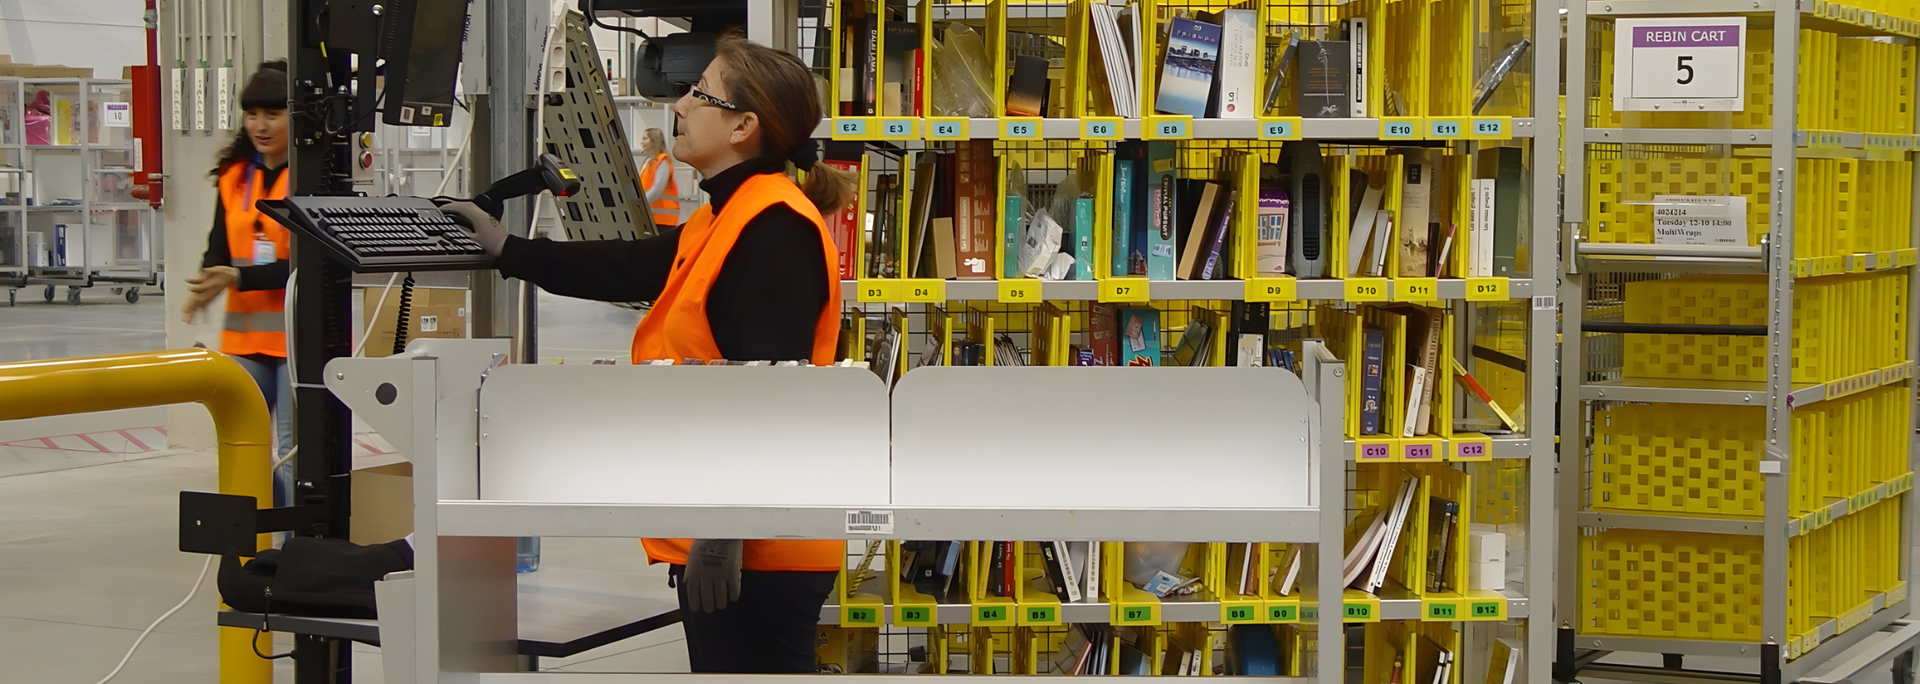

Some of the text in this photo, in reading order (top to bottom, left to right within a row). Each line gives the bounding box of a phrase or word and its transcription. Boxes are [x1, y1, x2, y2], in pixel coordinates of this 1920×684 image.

[1645, 30, 1727, 42] REBIN CART
[1676, 55, 1694, 85] 5
[113, 112, 123, 120] 10
[843, 123, 857, 132] E2
[889, 124, 904, 133] E3
[938, 126, 953, 134] E4
[1013, 125, 1027, 134] E5
[1093, 125, 1107, 134] E6
[1163, 125, 1177, 134] E8
[1269, 126, 1284, 135] E9
[1390, 126, 1411, 135] E10
[1437, 125, 1456, 134] E11
[1479, 123, 1499, 132] E12
[1657, 218, 1687, 227] Tuesday
[868, 289, 882, 297] D3
[914, 288, 928, 297] D4
[1116, 287, 1130, 295] D7
[1267, 286, 1281, 295] D9
[1357, 286, 1377, 295] D10
[1409, 285, 1428, 295] D11
[1477, 284, 1497, 293] D12
[1010, 289, 1024, 298] D5
[1366, 447, 1386, 456] C10
[1410, 448, 1429, 457] C11
[1462, 445, 1483, 454] C12
[983, 610, 997, 619] B4
[1128, 610, 1142, 619] B7
[1348, 607, 1368, 616] B10
[1433, 607, 1452, 616] B11
[1476, 606, 1496, 614] B12
[852, 611, 867, 620] B2
[906, 611, 921, 620] B3
[1032, 611, 1046, 619] B5
